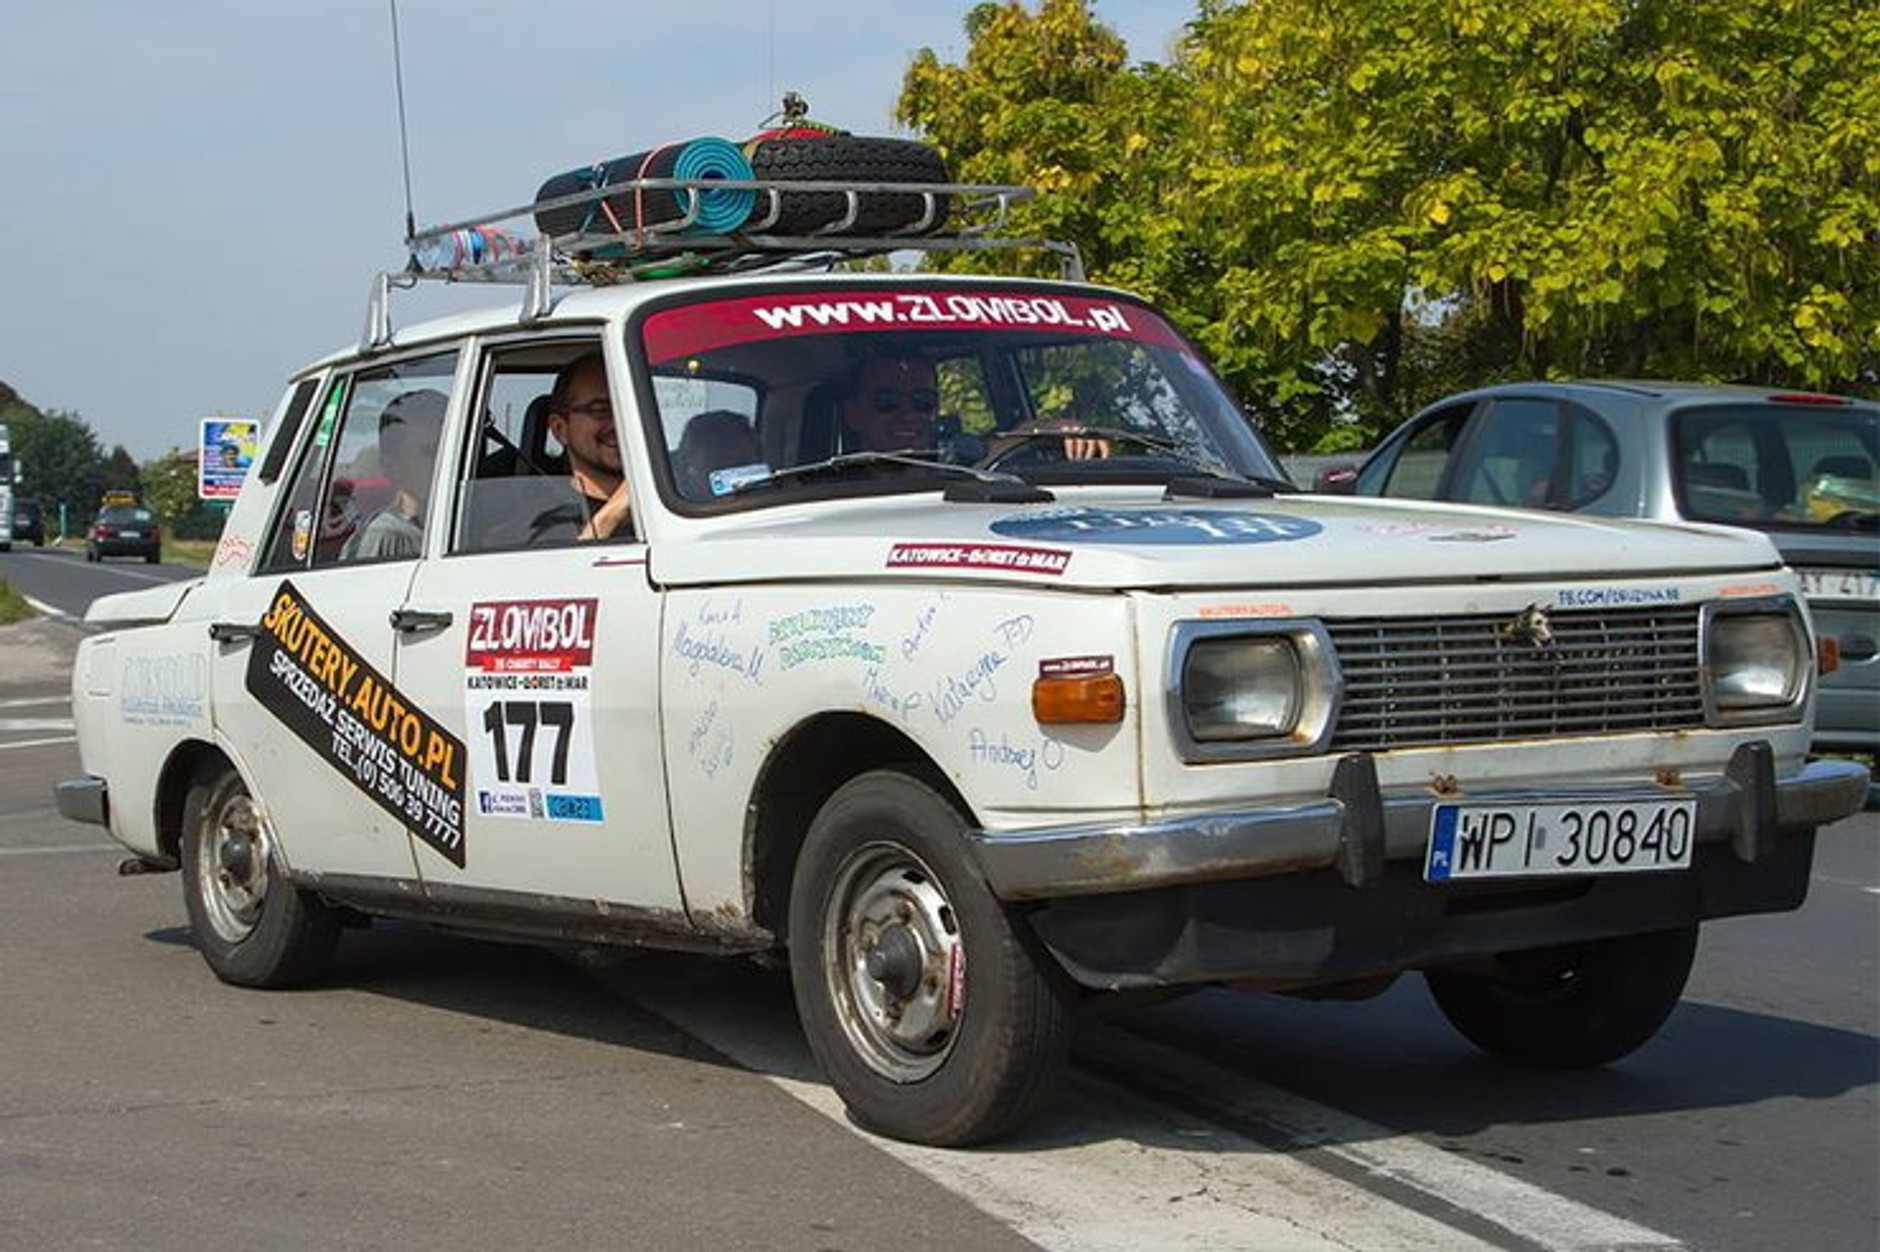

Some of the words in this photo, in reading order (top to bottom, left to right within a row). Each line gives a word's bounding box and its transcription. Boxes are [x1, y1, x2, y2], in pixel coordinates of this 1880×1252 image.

[753, 295, 1132, 332] www.ZLOMBOL.pl
[470, 604, 592, 651] ZLOMBOL
[263, 593, 457, 790] SKUTERY.AUTO.PL
[335, 710, 396, 774] SERWIS
[399, 756, 462, 827] TUNING
[483, 701, 575, 786] 177
[424, 810, 462, 850] 7777
[1460, 812, 1536, 870] WPI
[1556, 808, 1689, 867] 30840
